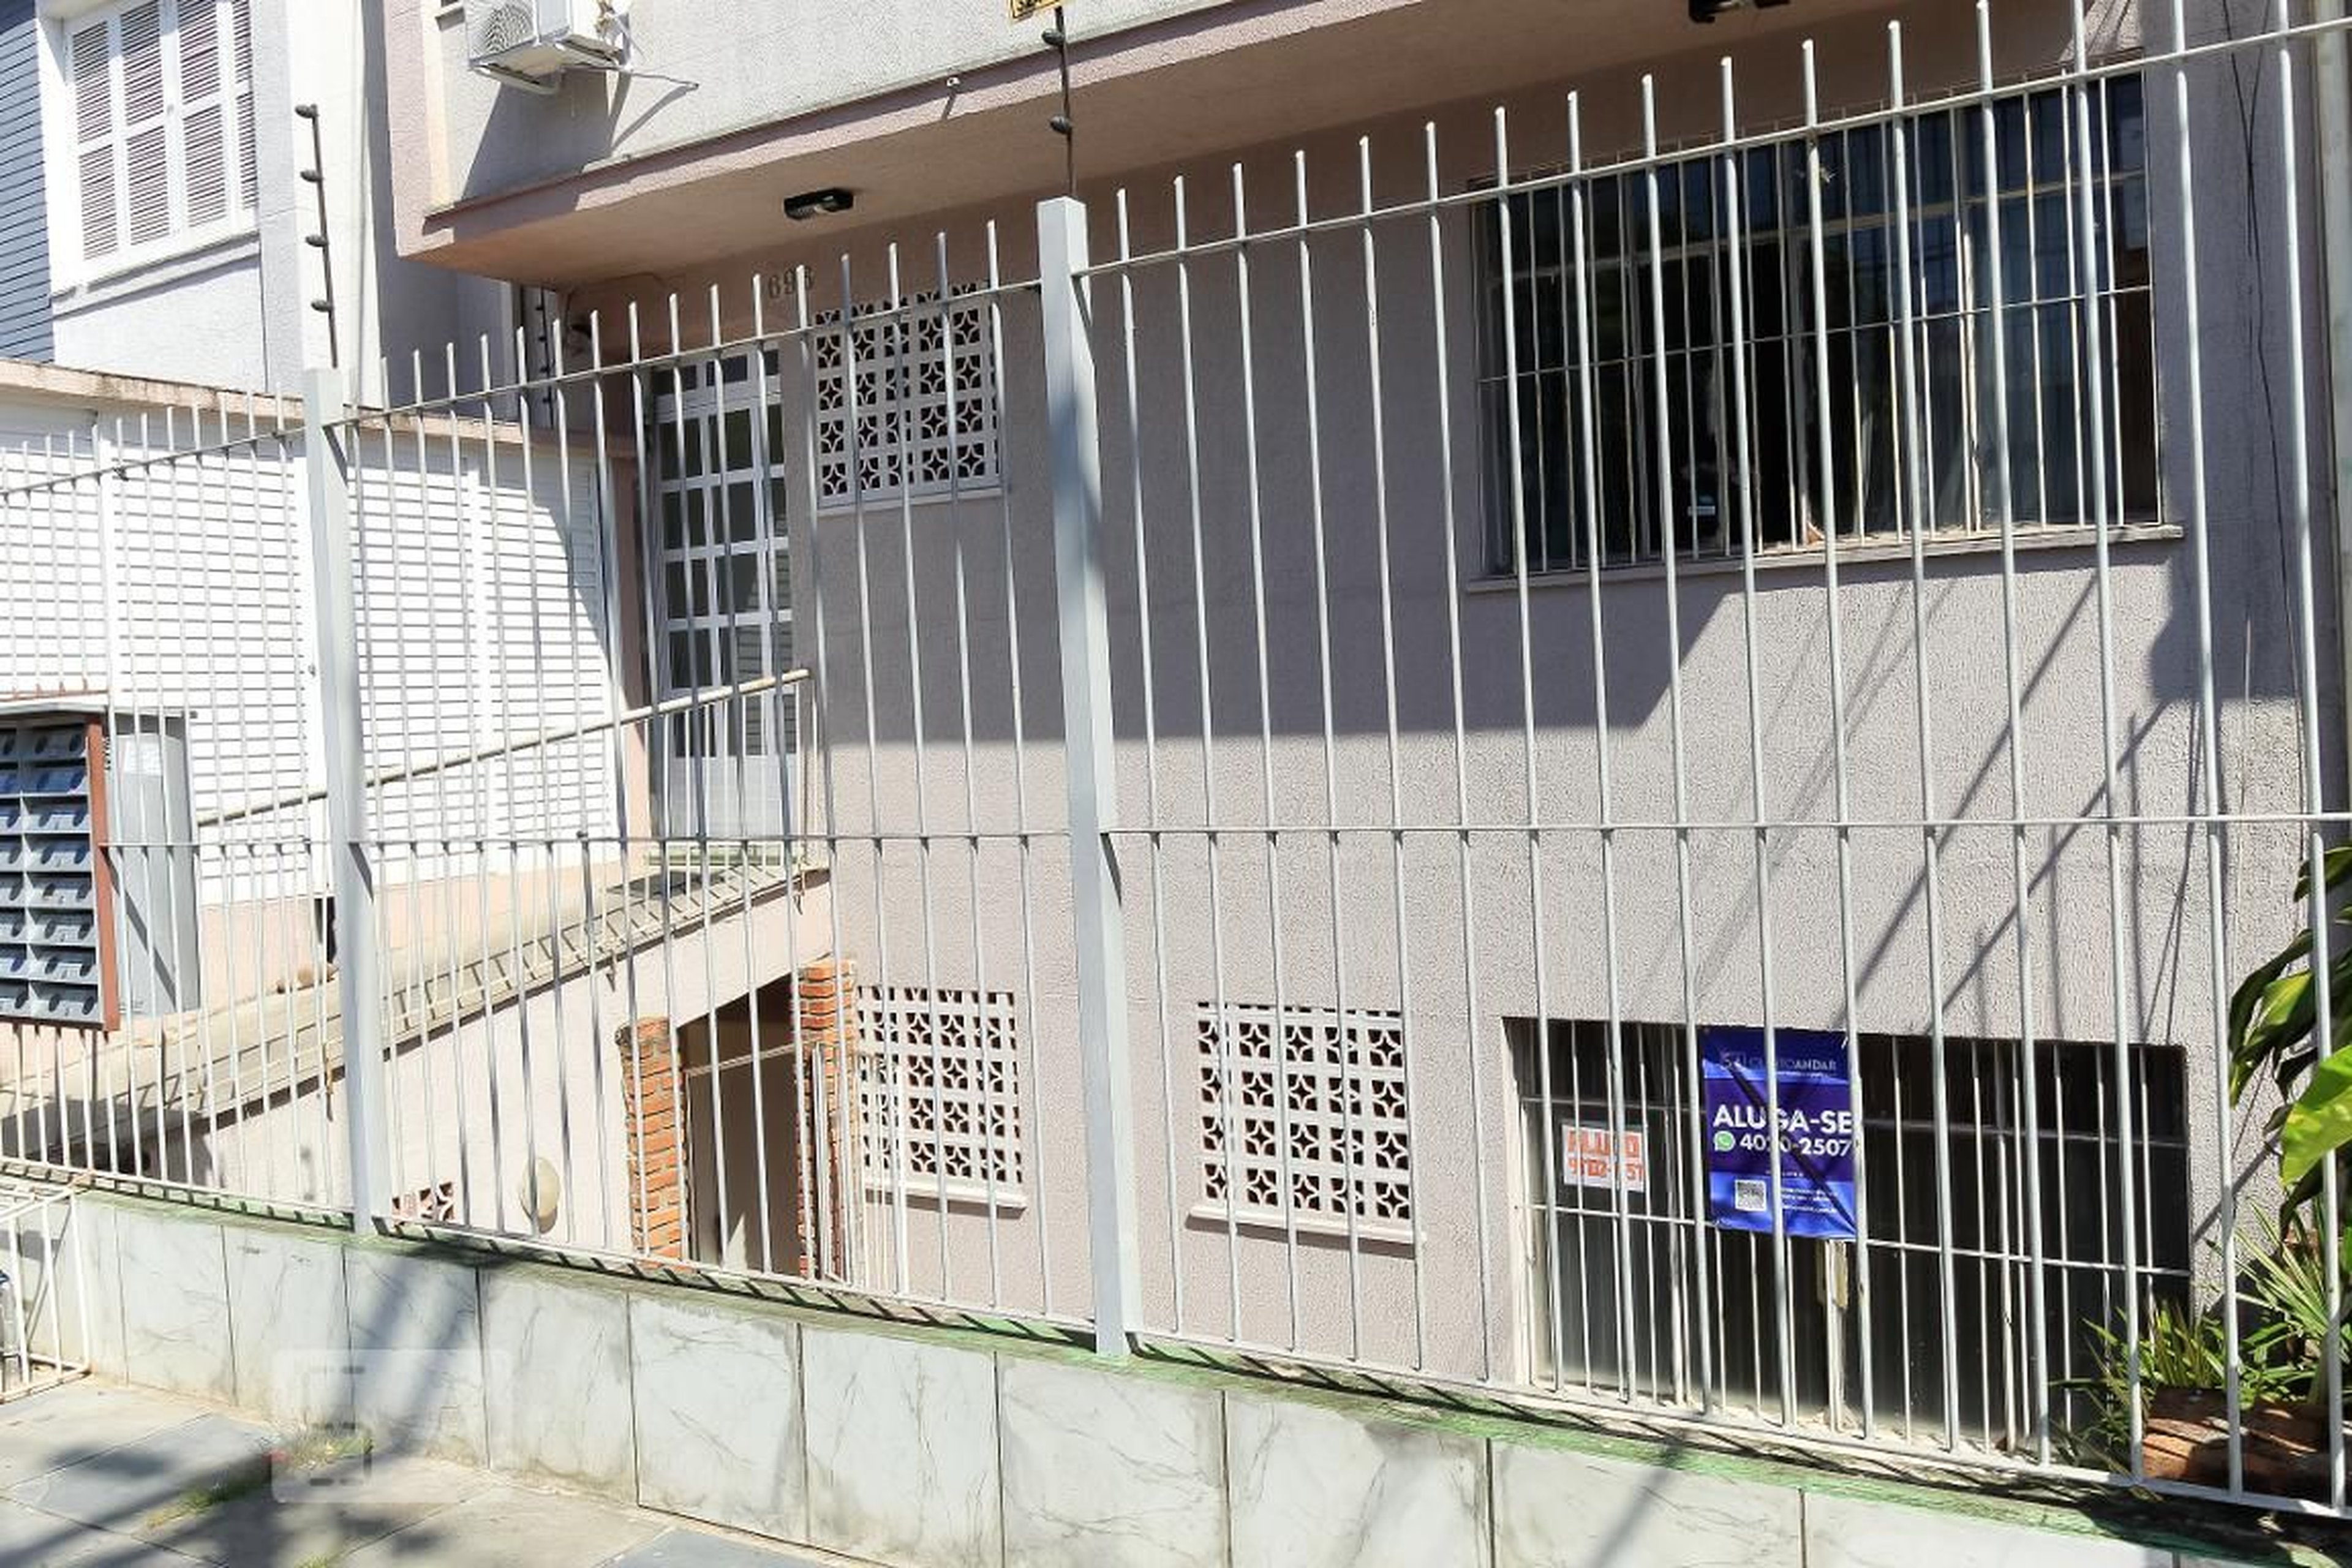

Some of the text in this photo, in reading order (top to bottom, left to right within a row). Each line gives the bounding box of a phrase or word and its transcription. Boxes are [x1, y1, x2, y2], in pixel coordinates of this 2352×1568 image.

[1713, 1104, 1852, 1134] ALUGA-SE
[1567, 1130, 1641, 1158] ALUO
[1740, 1134, 1851, 1156] 400-2507
